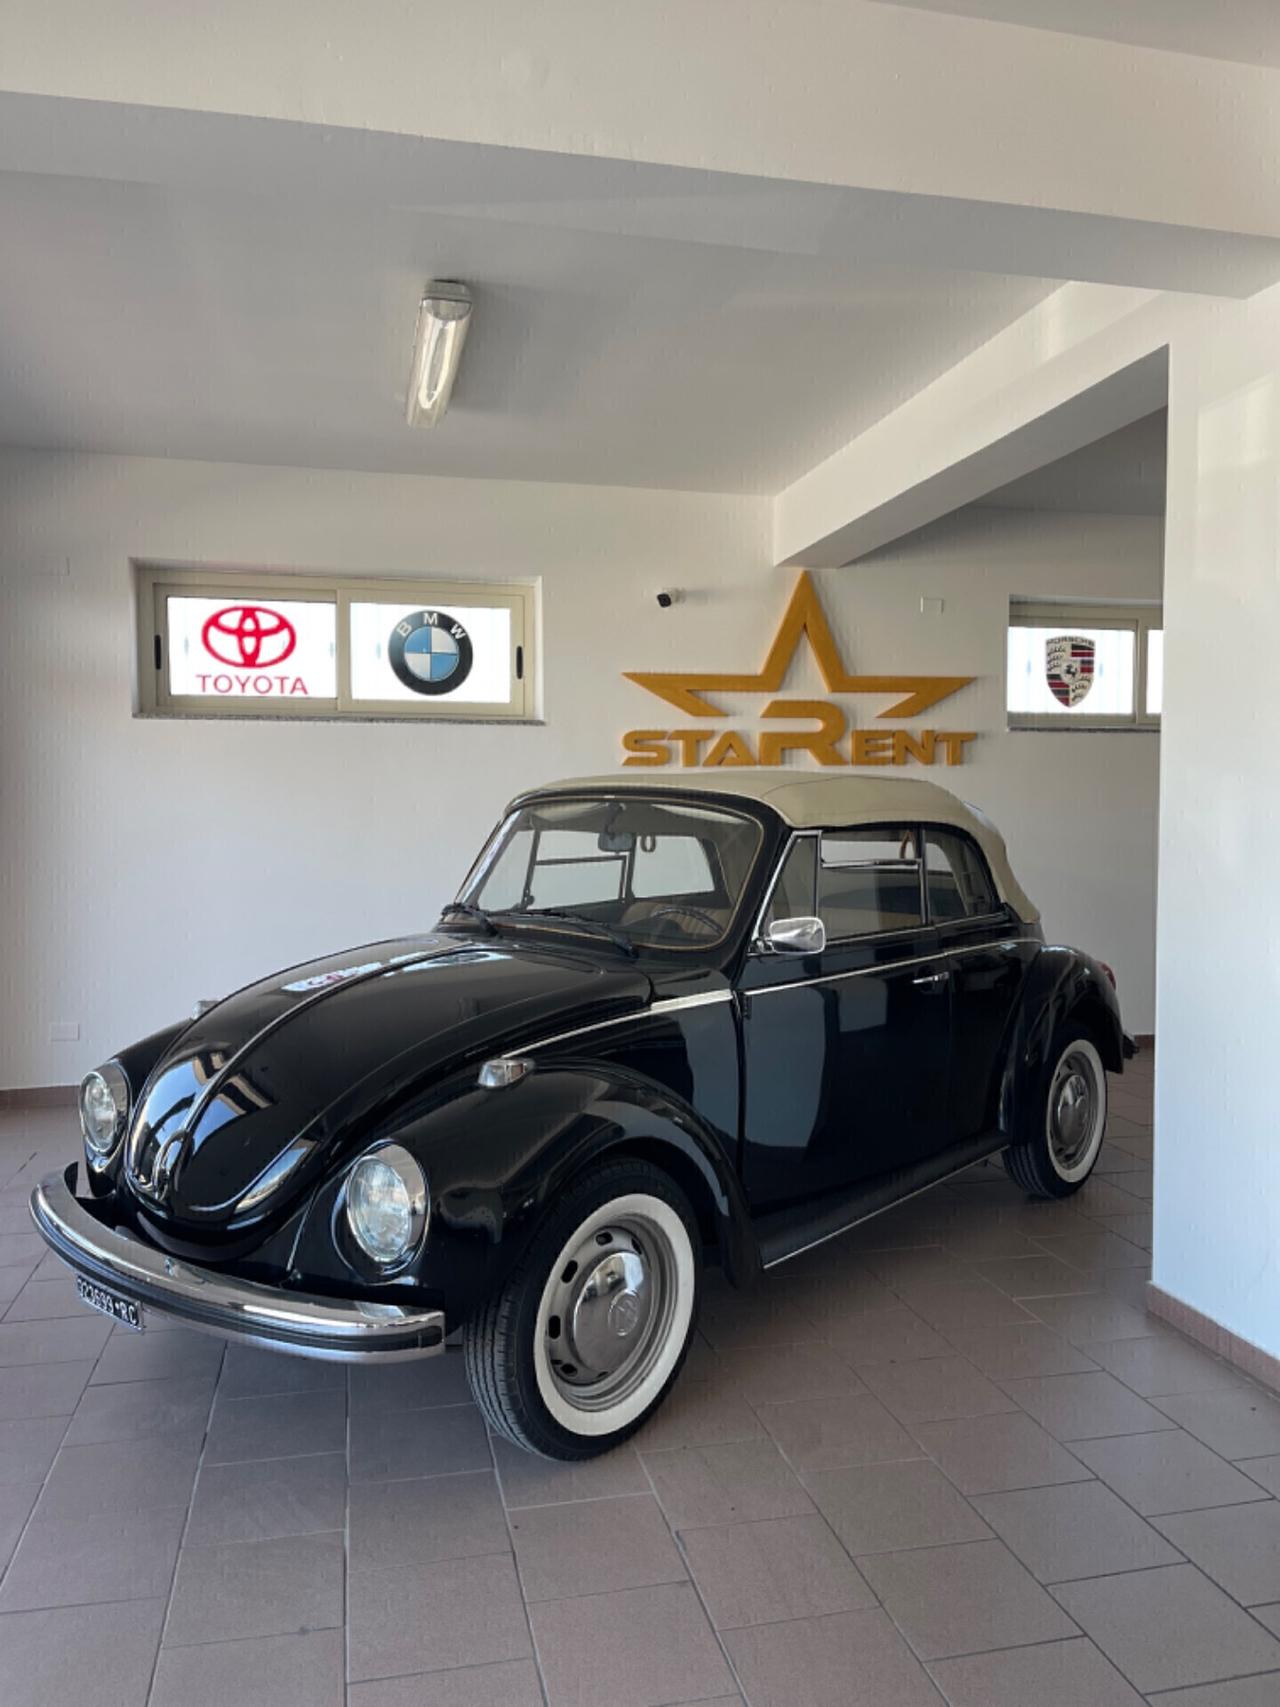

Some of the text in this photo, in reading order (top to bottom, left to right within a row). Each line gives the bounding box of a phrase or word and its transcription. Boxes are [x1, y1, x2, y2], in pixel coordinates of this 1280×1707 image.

[396, 612, 467, 640] BMW
[195, 673, 309, 695] TOYOTA
[621, 699, 979, 767] STARENT
